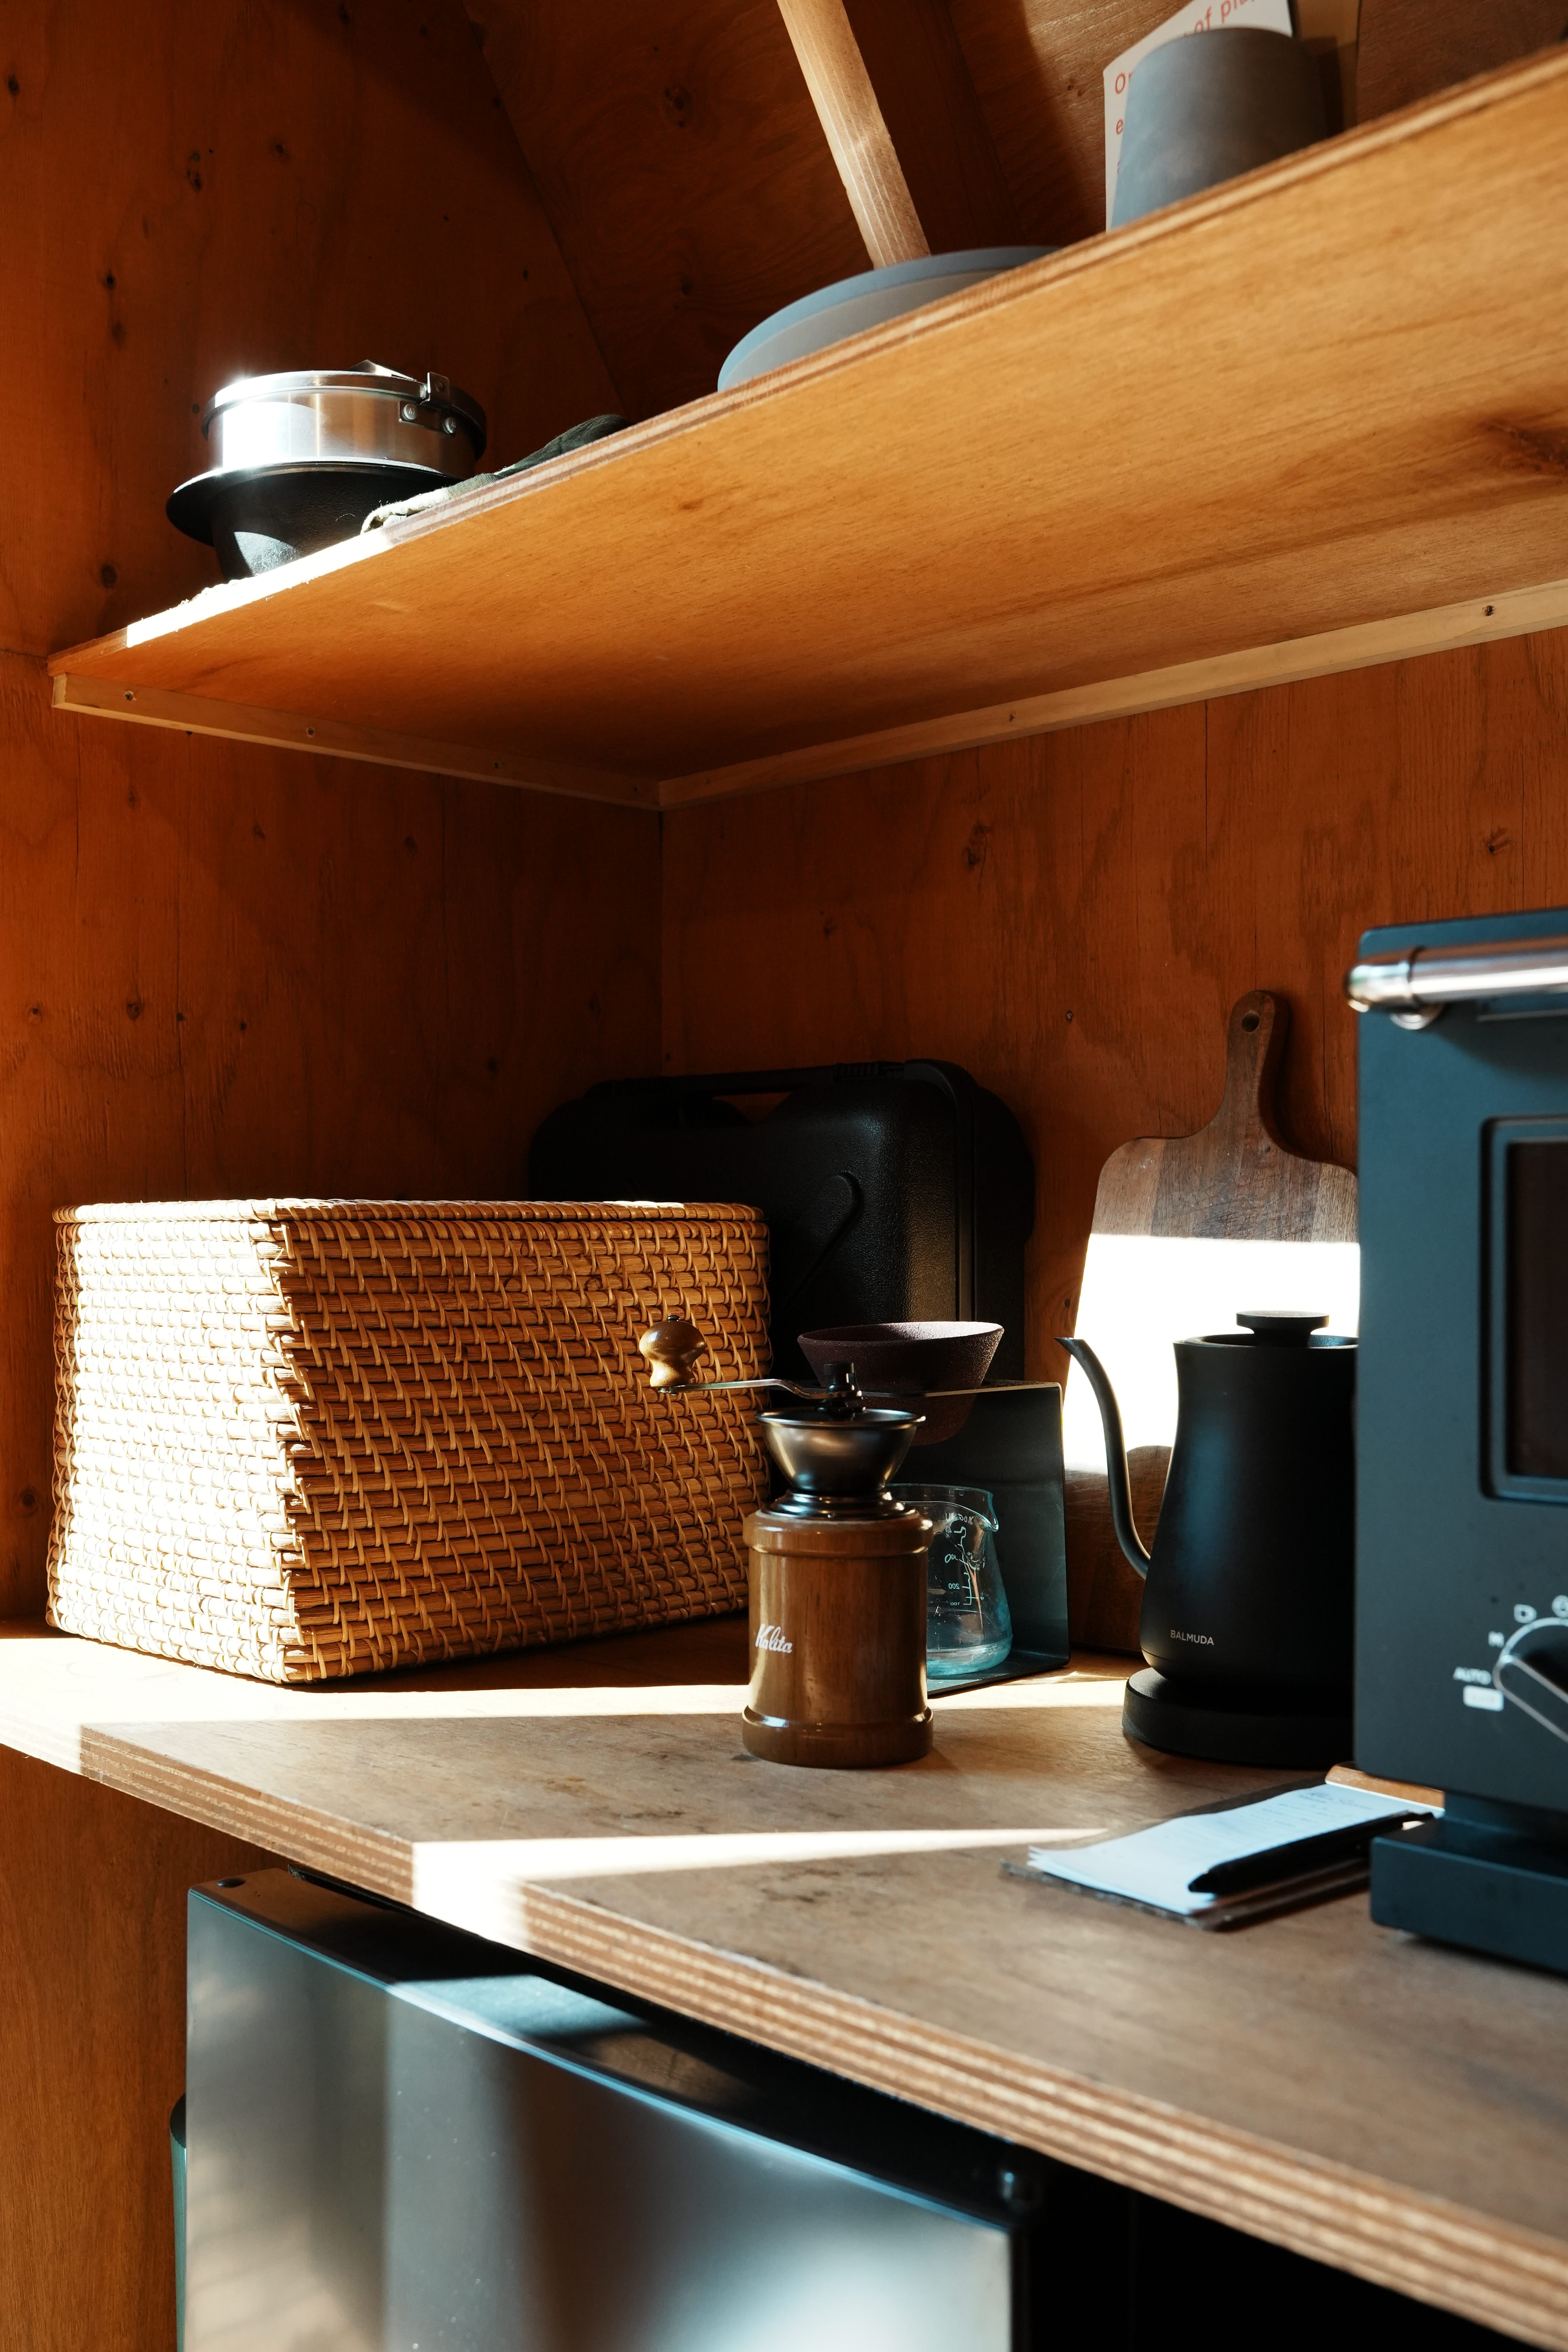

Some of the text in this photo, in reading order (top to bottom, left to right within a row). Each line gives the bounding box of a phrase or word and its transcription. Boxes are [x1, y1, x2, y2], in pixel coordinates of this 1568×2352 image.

[1194, 6, 1211, 33] of
[755, 1623, 793, 1653] Kalita
[1170, 1630, 1214, 1645] BALMUDA
